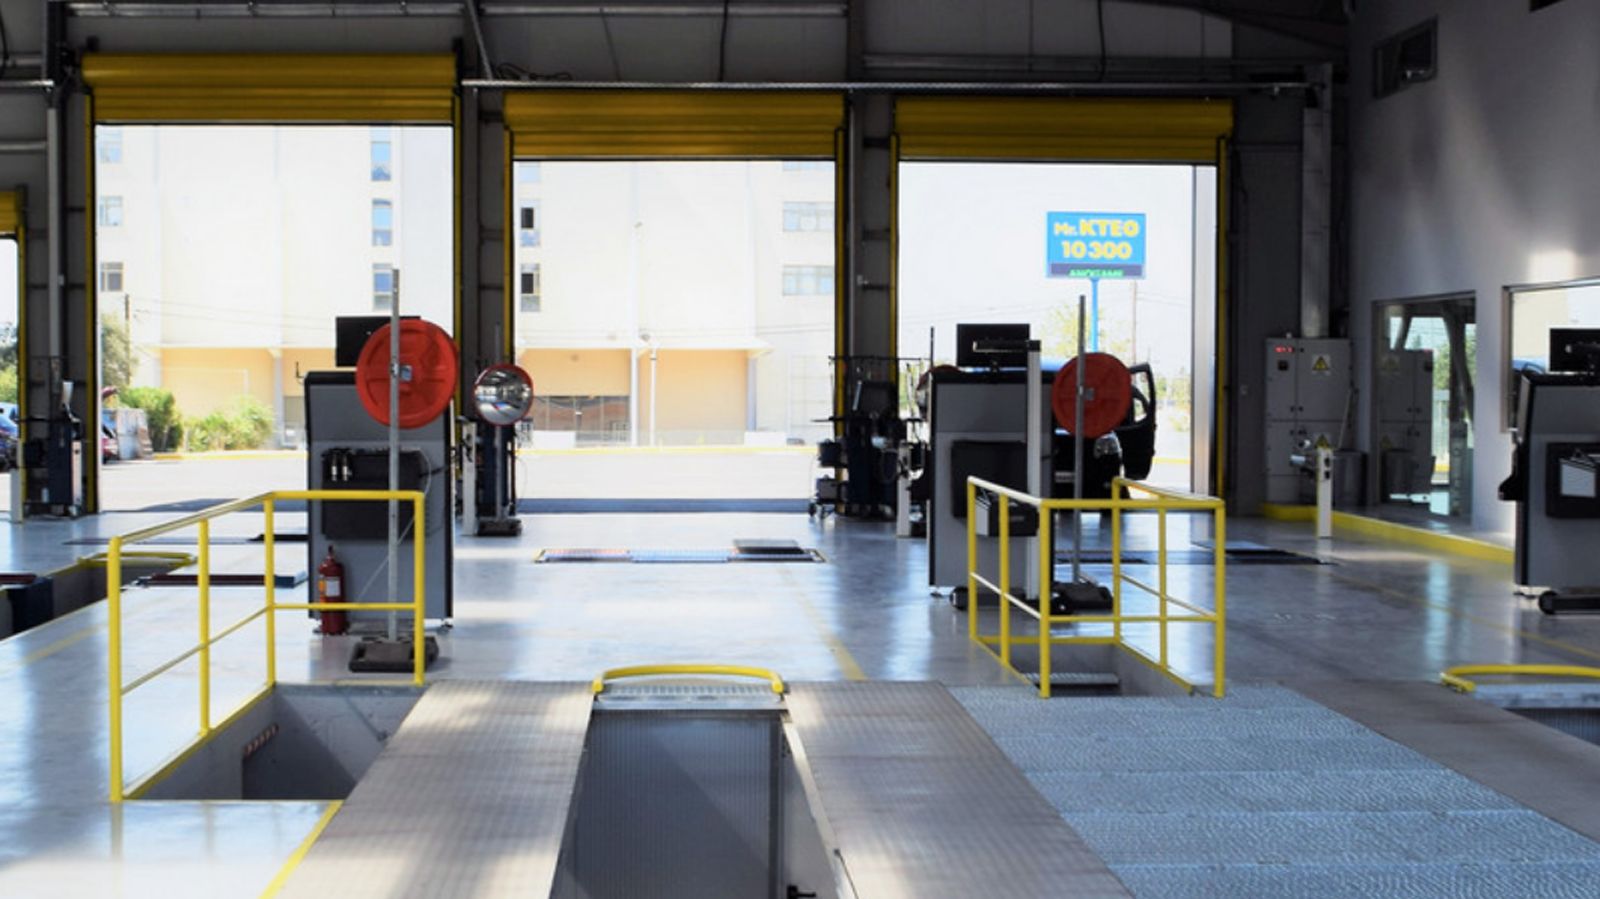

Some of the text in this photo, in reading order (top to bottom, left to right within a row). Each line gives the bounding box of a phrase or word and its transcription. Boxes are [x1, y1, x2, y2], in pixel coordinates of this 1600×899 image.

[1054, 222, 1076, 236] Mr.
[1062, 240, 1132, 259] 10 300
